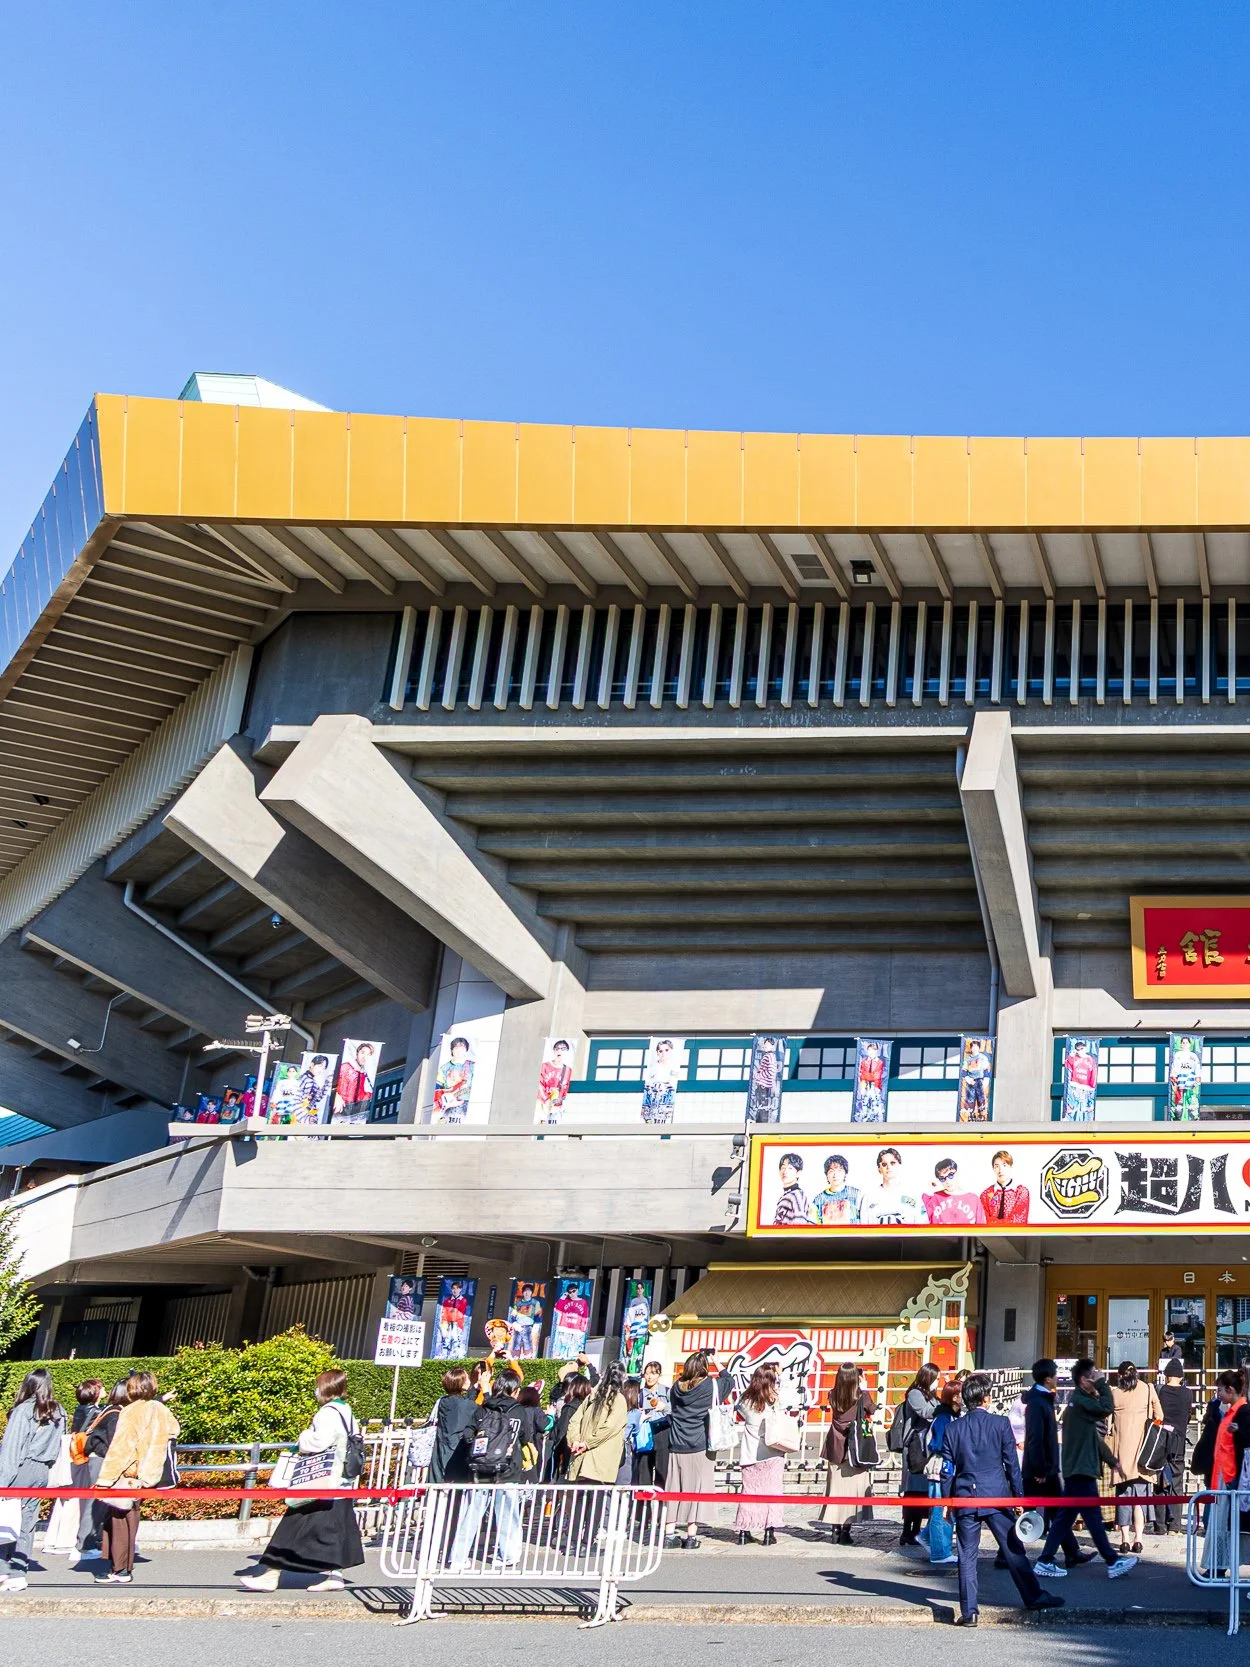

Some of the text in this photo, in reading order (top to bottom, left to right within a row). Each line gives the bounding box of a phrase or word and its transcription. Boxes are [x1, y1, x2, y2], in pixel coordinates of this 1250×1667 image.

[378, 1347, 419, 1358] お願いします
